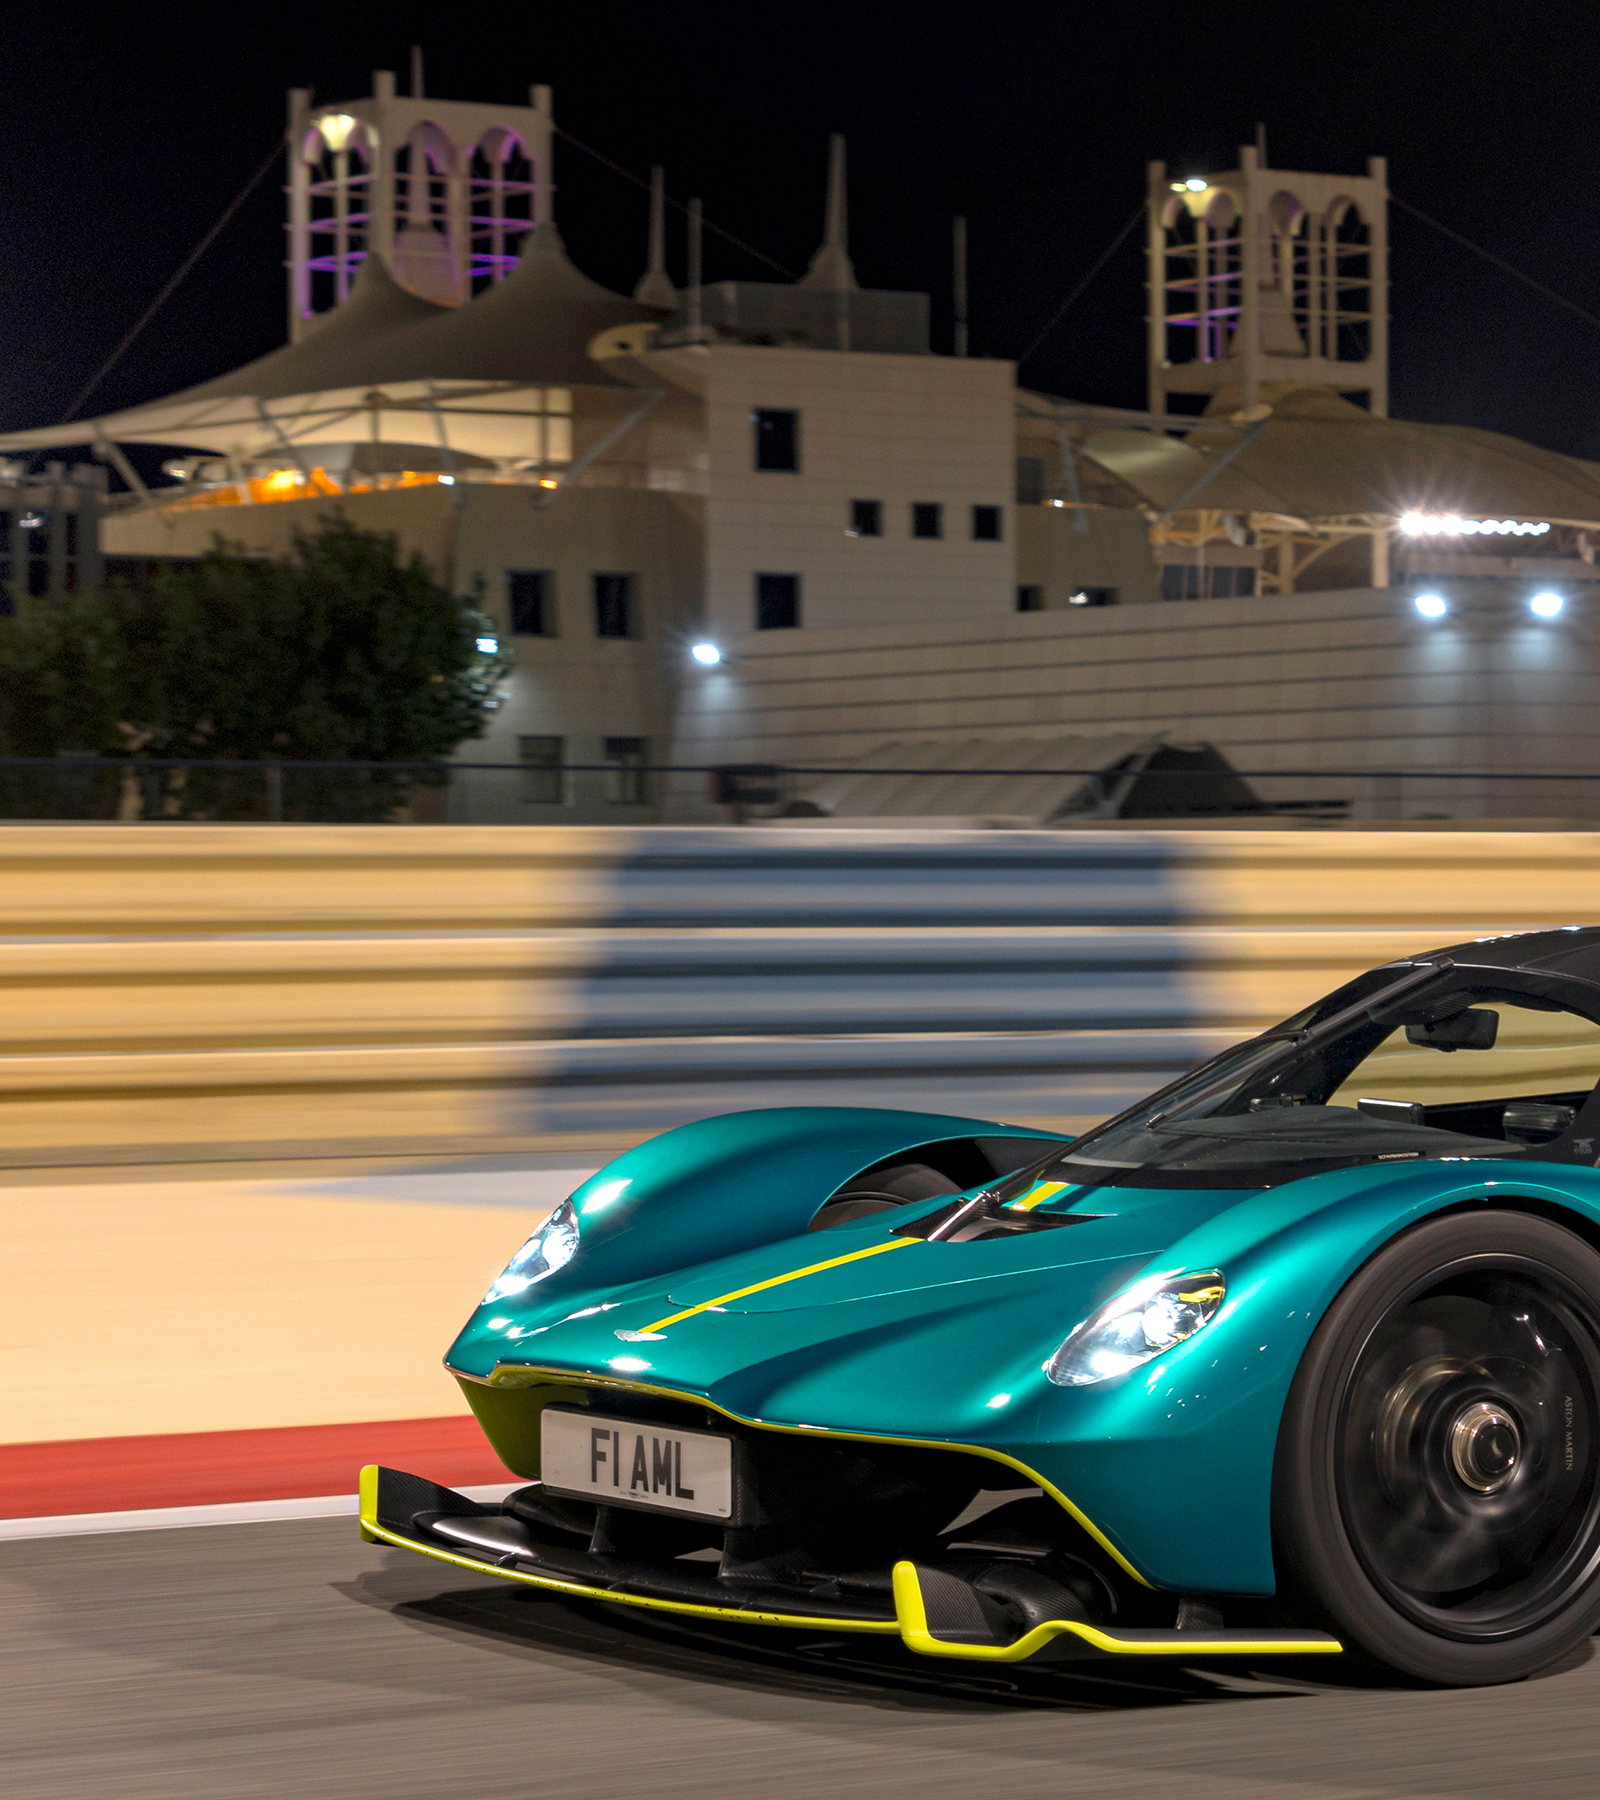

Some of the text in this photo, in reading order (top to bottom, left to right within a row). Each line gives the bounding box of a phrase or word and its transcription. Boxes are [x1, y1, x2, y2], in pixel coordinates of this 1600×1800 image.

[630, 1434, 695, 1501] AML
[1564, 1395, 1573, 1471] ASTON MARTIN
